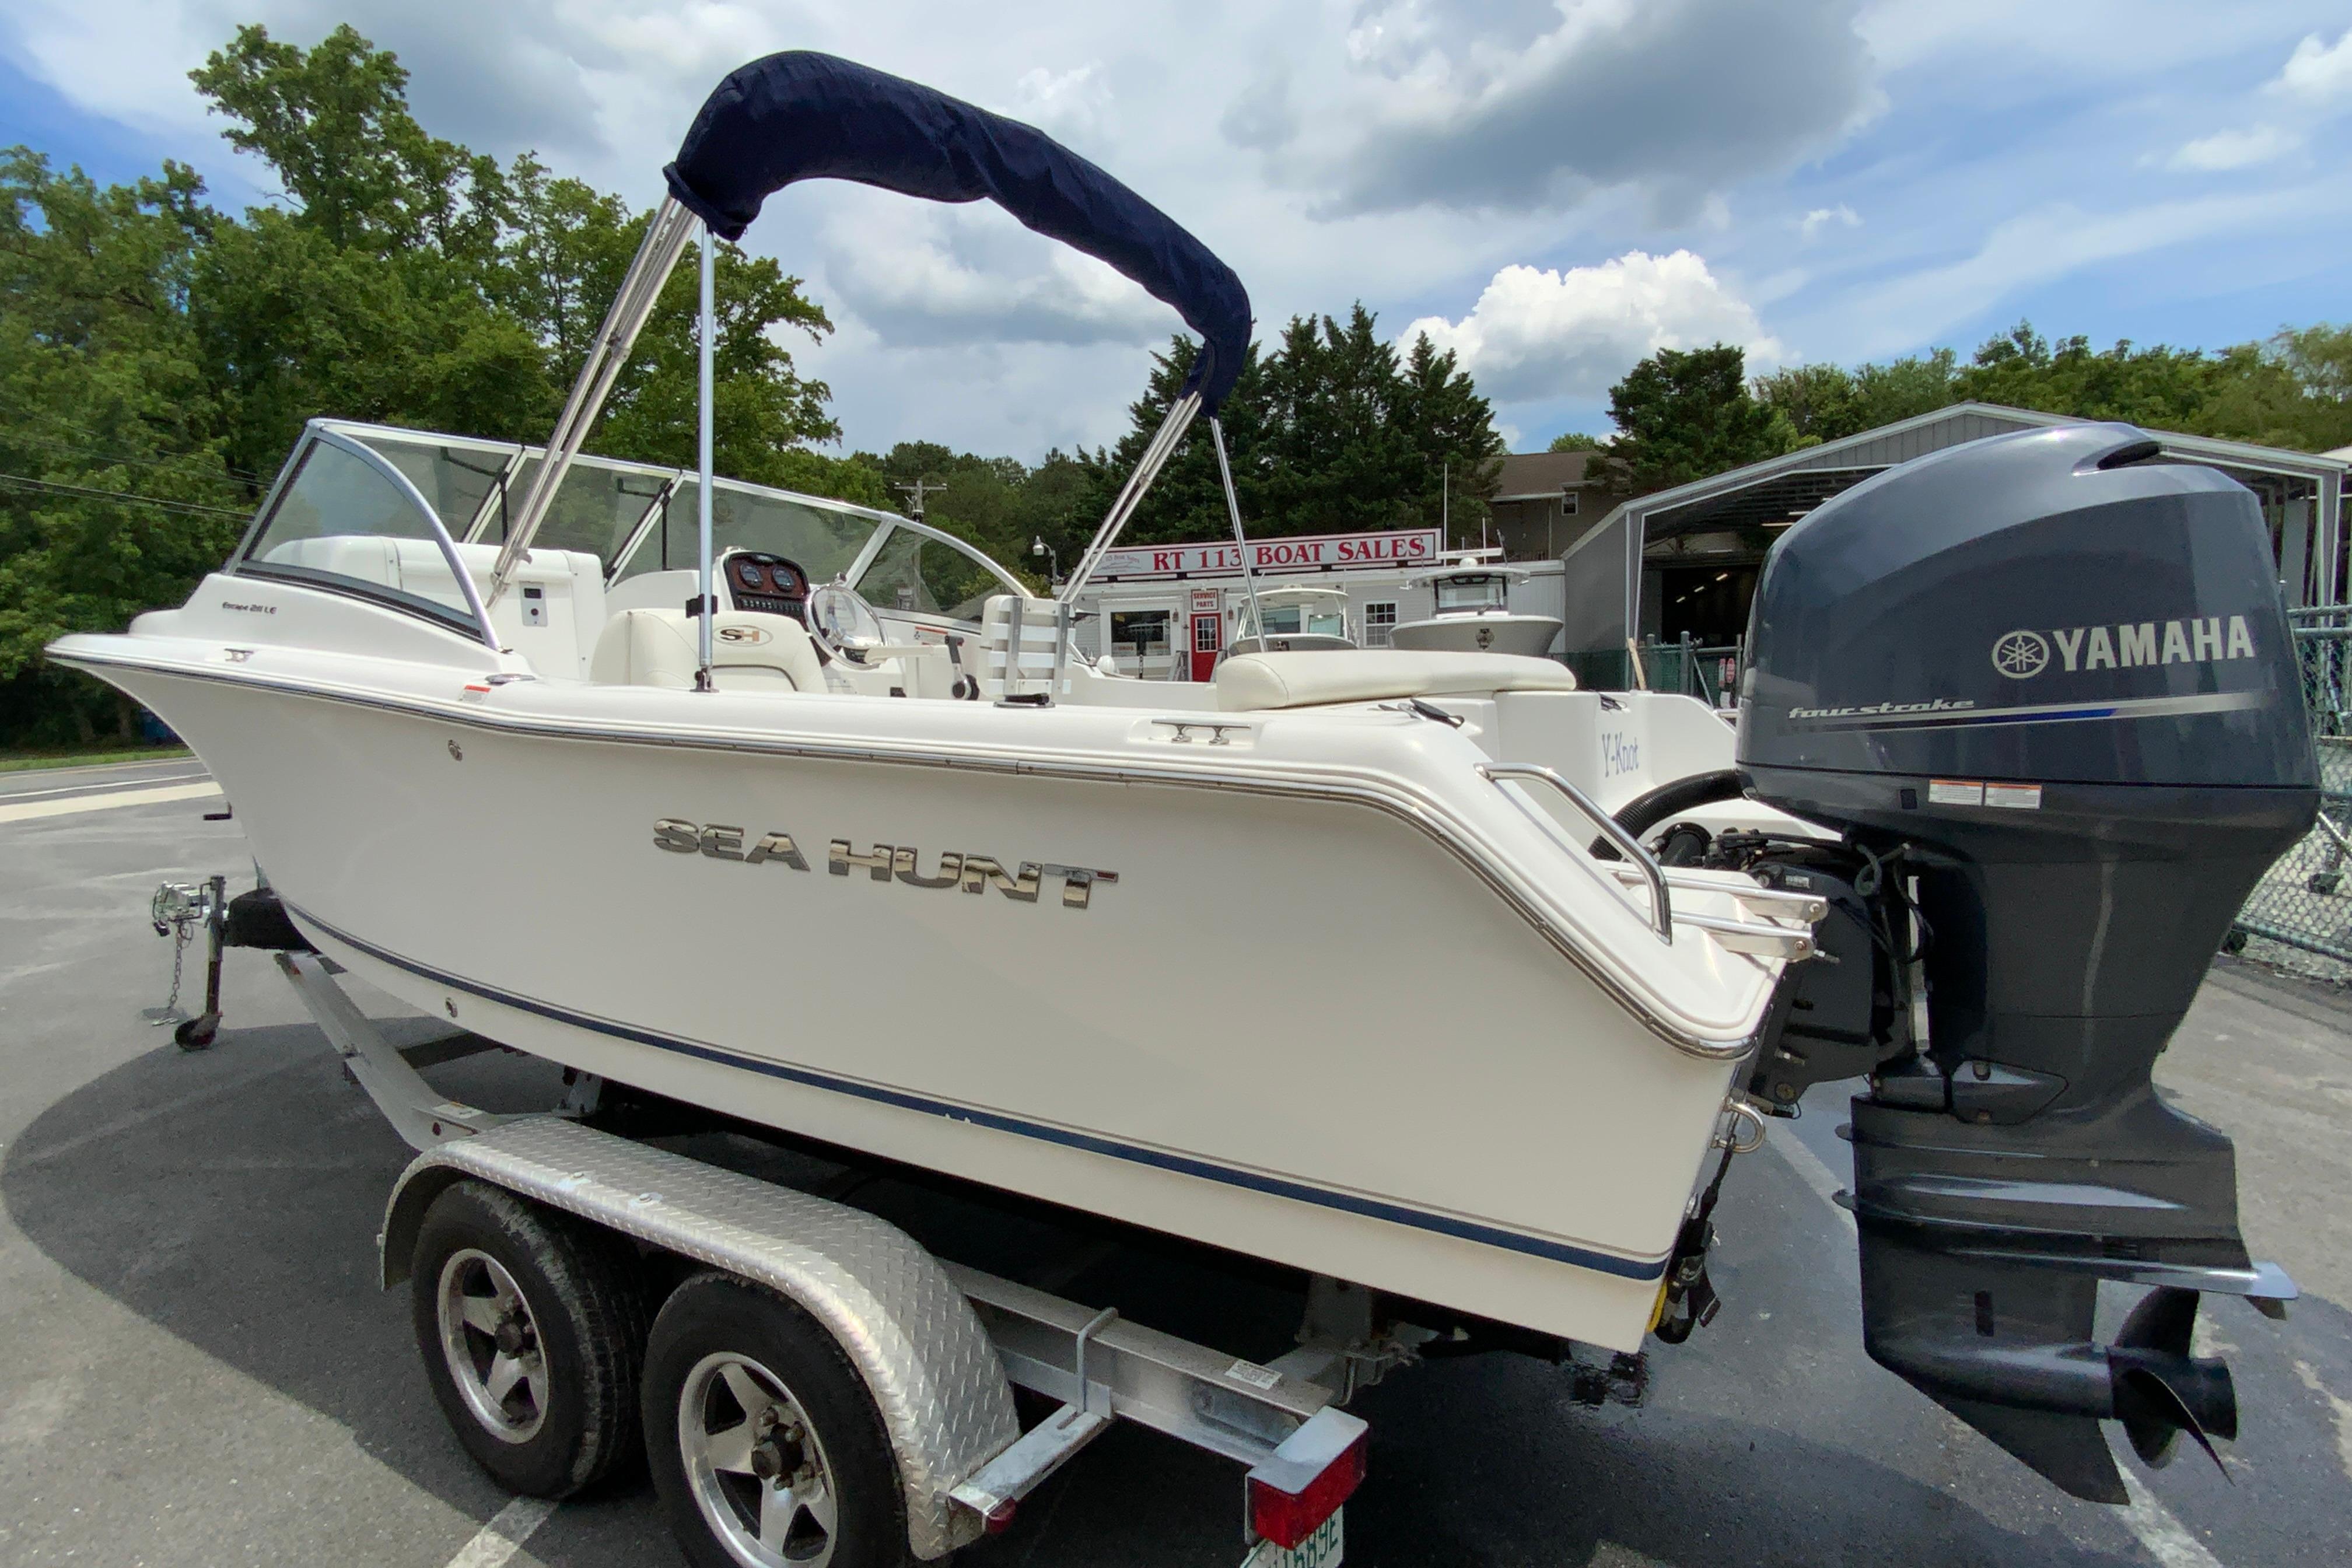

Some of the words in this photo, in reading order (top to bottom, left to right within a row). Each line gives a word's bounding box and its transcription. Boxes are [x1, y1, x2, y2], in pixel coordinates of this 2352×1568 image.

[1153, 551, 1185, 570] RT
[1198, 548, 1242, 568] 113
[1256, 543, 1325, 565] BOAT
[1338, 537, 1425, 561] SALES
[1194, 592, 1216, 600] SERVICE
[2053, 615, 2255, 671] YAMAHA
[1788, 706, 1856, 719] four
[1859, 698, 1975, 715] stroke
[653, 817, 811, 872] SEA
[828, 838, 1119, 909] HUNT
